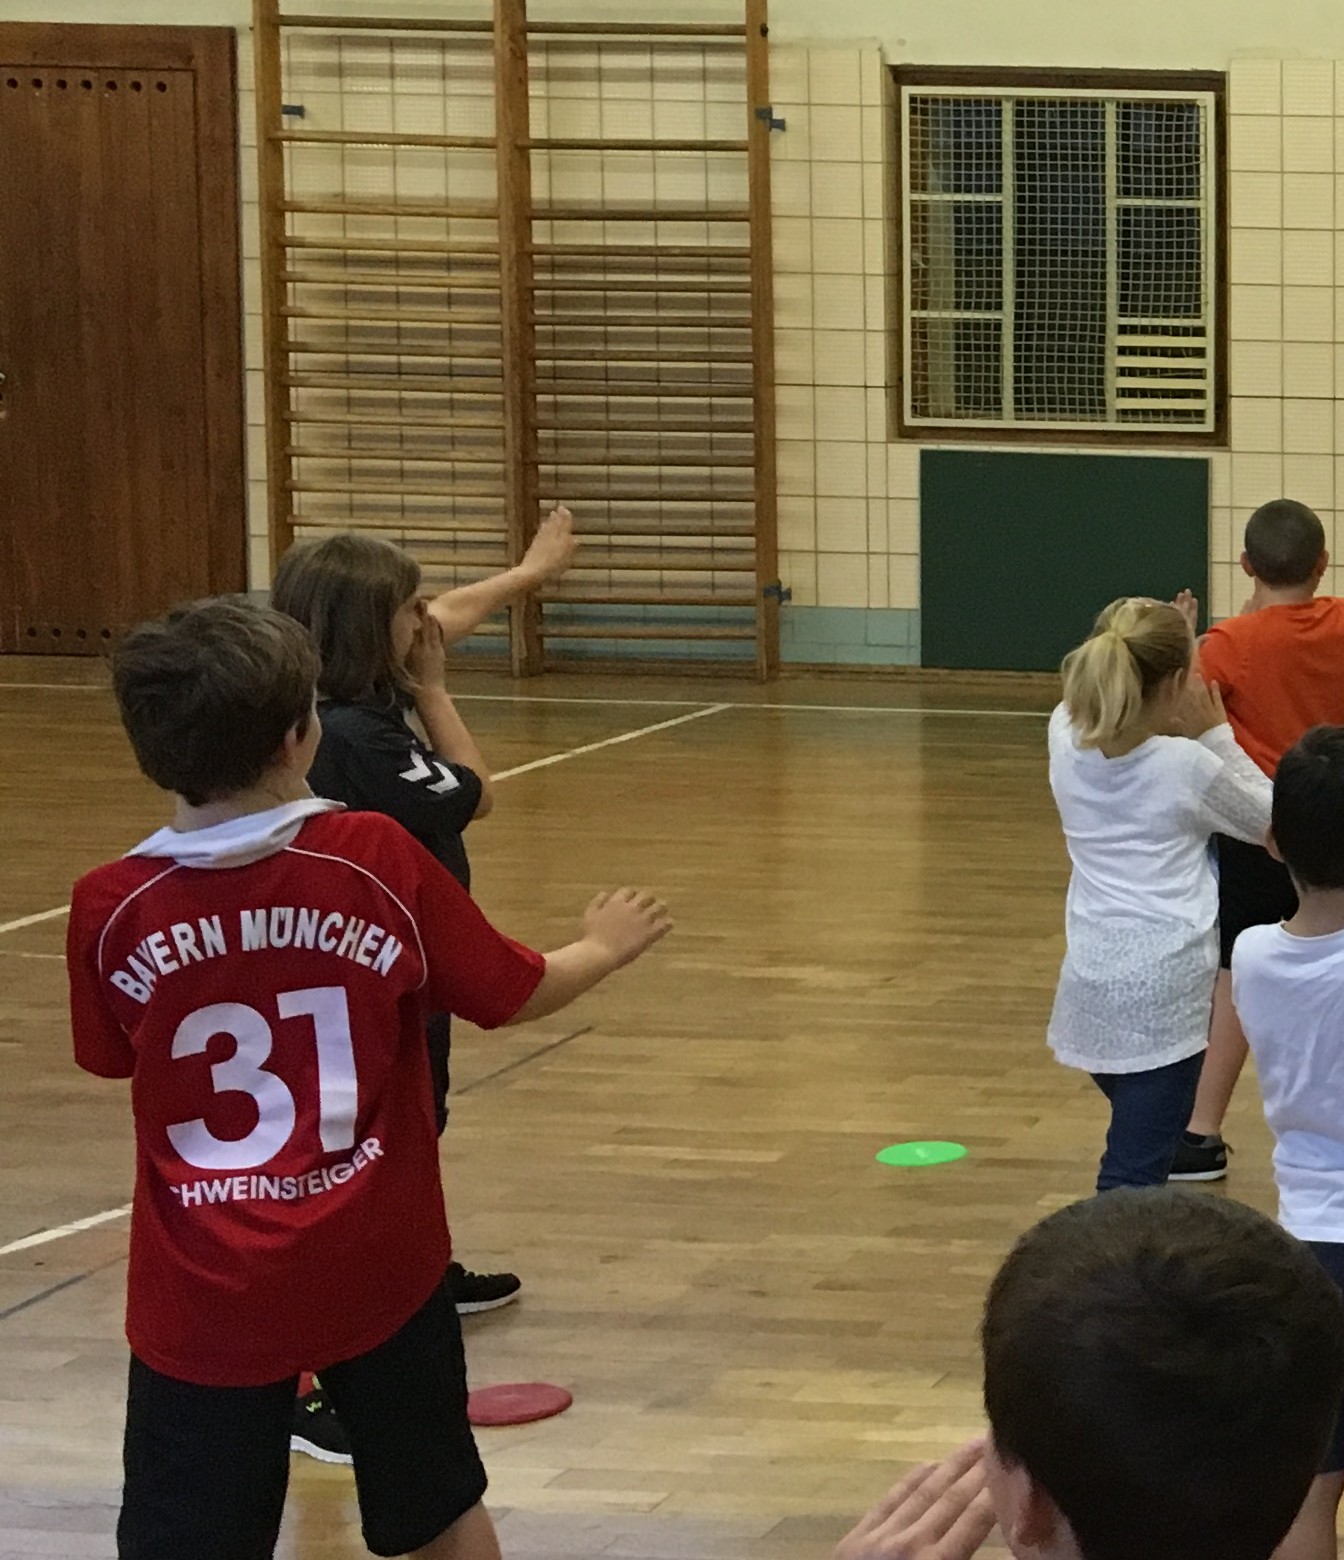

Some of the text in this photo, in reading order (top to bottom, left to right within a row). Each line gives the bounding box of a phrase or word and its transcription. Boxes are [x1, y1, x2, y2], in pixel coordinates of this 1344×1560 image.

[109, 906, 403, 1005] BAYERN MÜNCHEN
[166, 985, 359, 1170] 31
